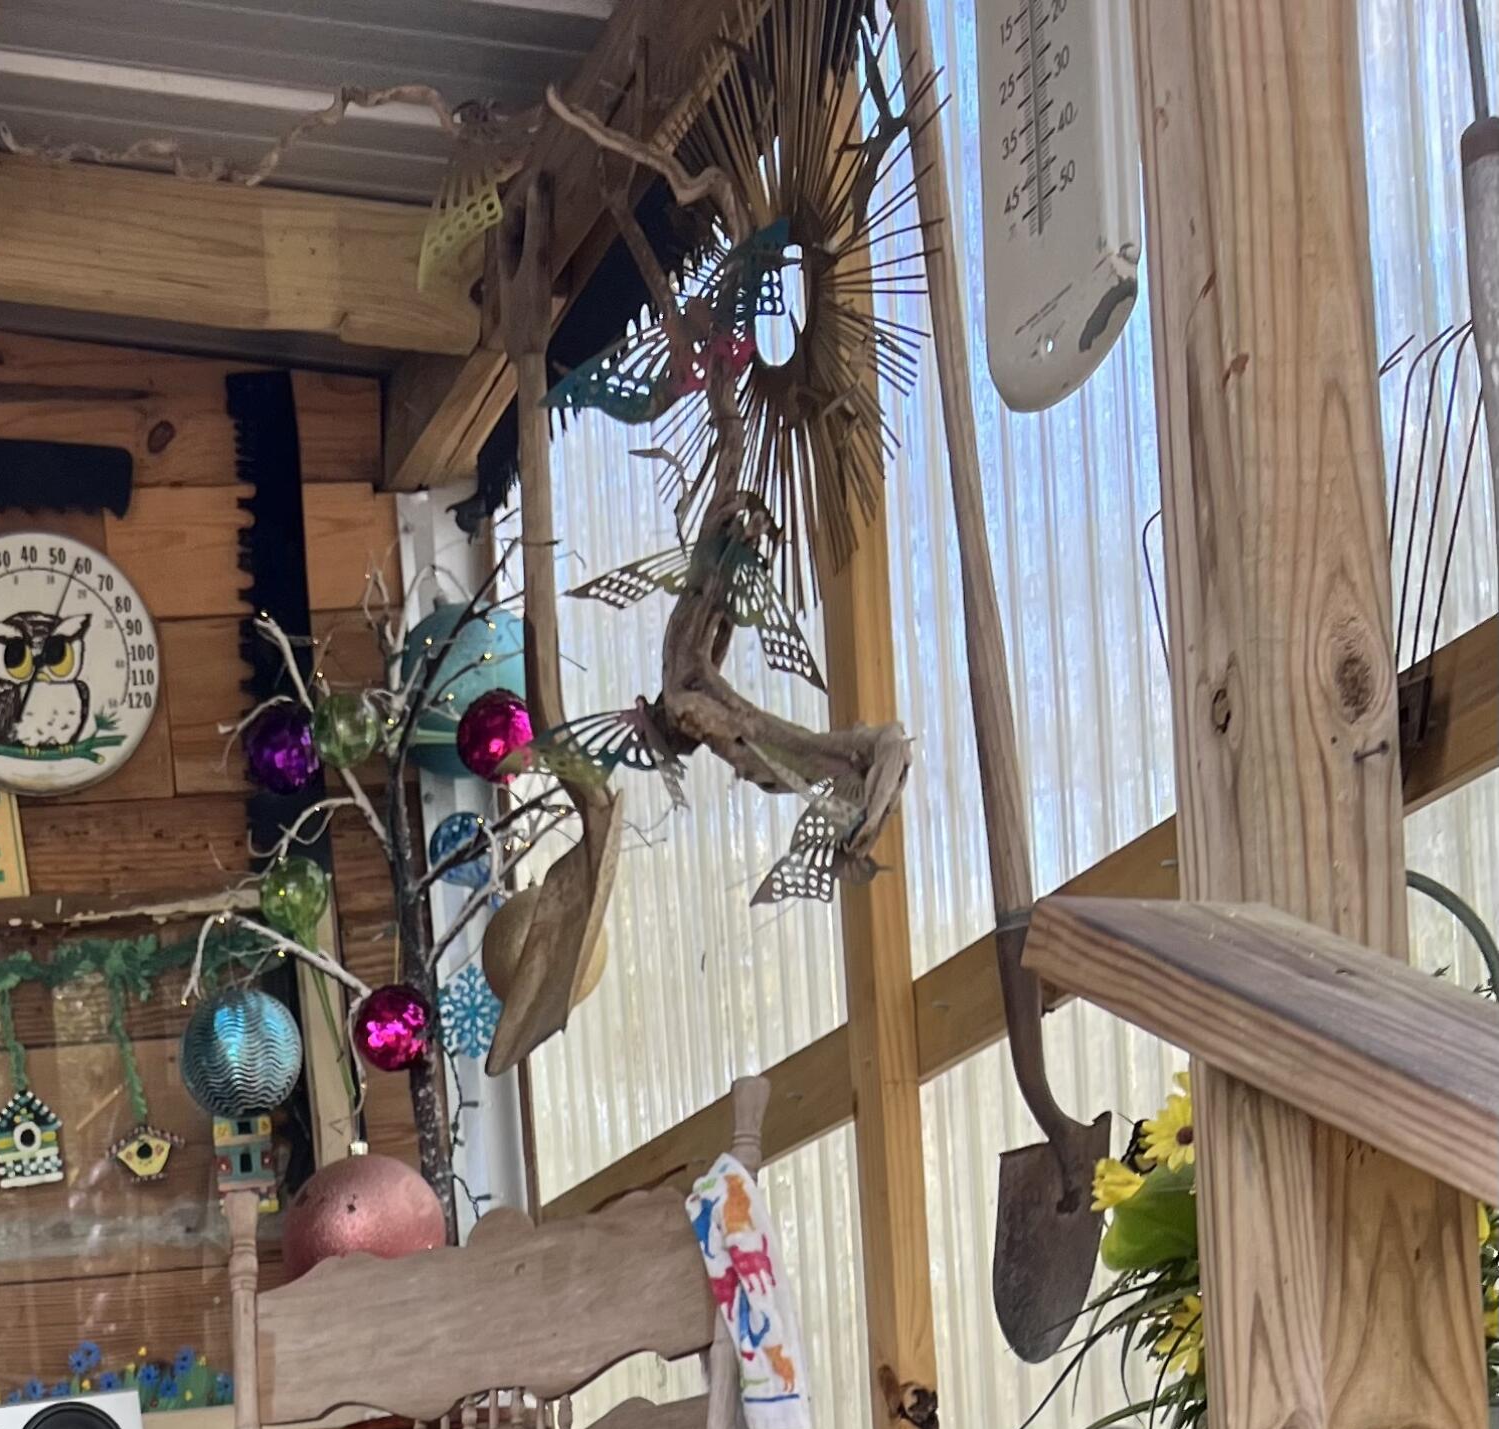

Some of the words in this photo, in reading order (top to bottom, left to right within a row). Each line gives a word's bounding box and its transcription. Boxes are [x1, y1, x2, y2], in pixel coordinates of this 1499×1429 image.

[1000, 15, 1013, 47] 15
[1053, 45, 1070, 77] 30
[999, 73, 1015, 106] 25
[1002, 128, 1017, 160] 35
[1060, 159, 1076, 192] 50
[1004, 186, 1019, 214] 45
[20, 546, 37, 563] 40
[49, 547, 66, 565] 50
[74, 557, 92, 575] 60
[97, 574, 114, 592] 70
[114, 596, 132, 613] 80
[126, 619, 143, 636] 90
[131, 644, 155, 661] 100
[132, 669, 155, 686] 110
[128, 691, 152, 709] 120
